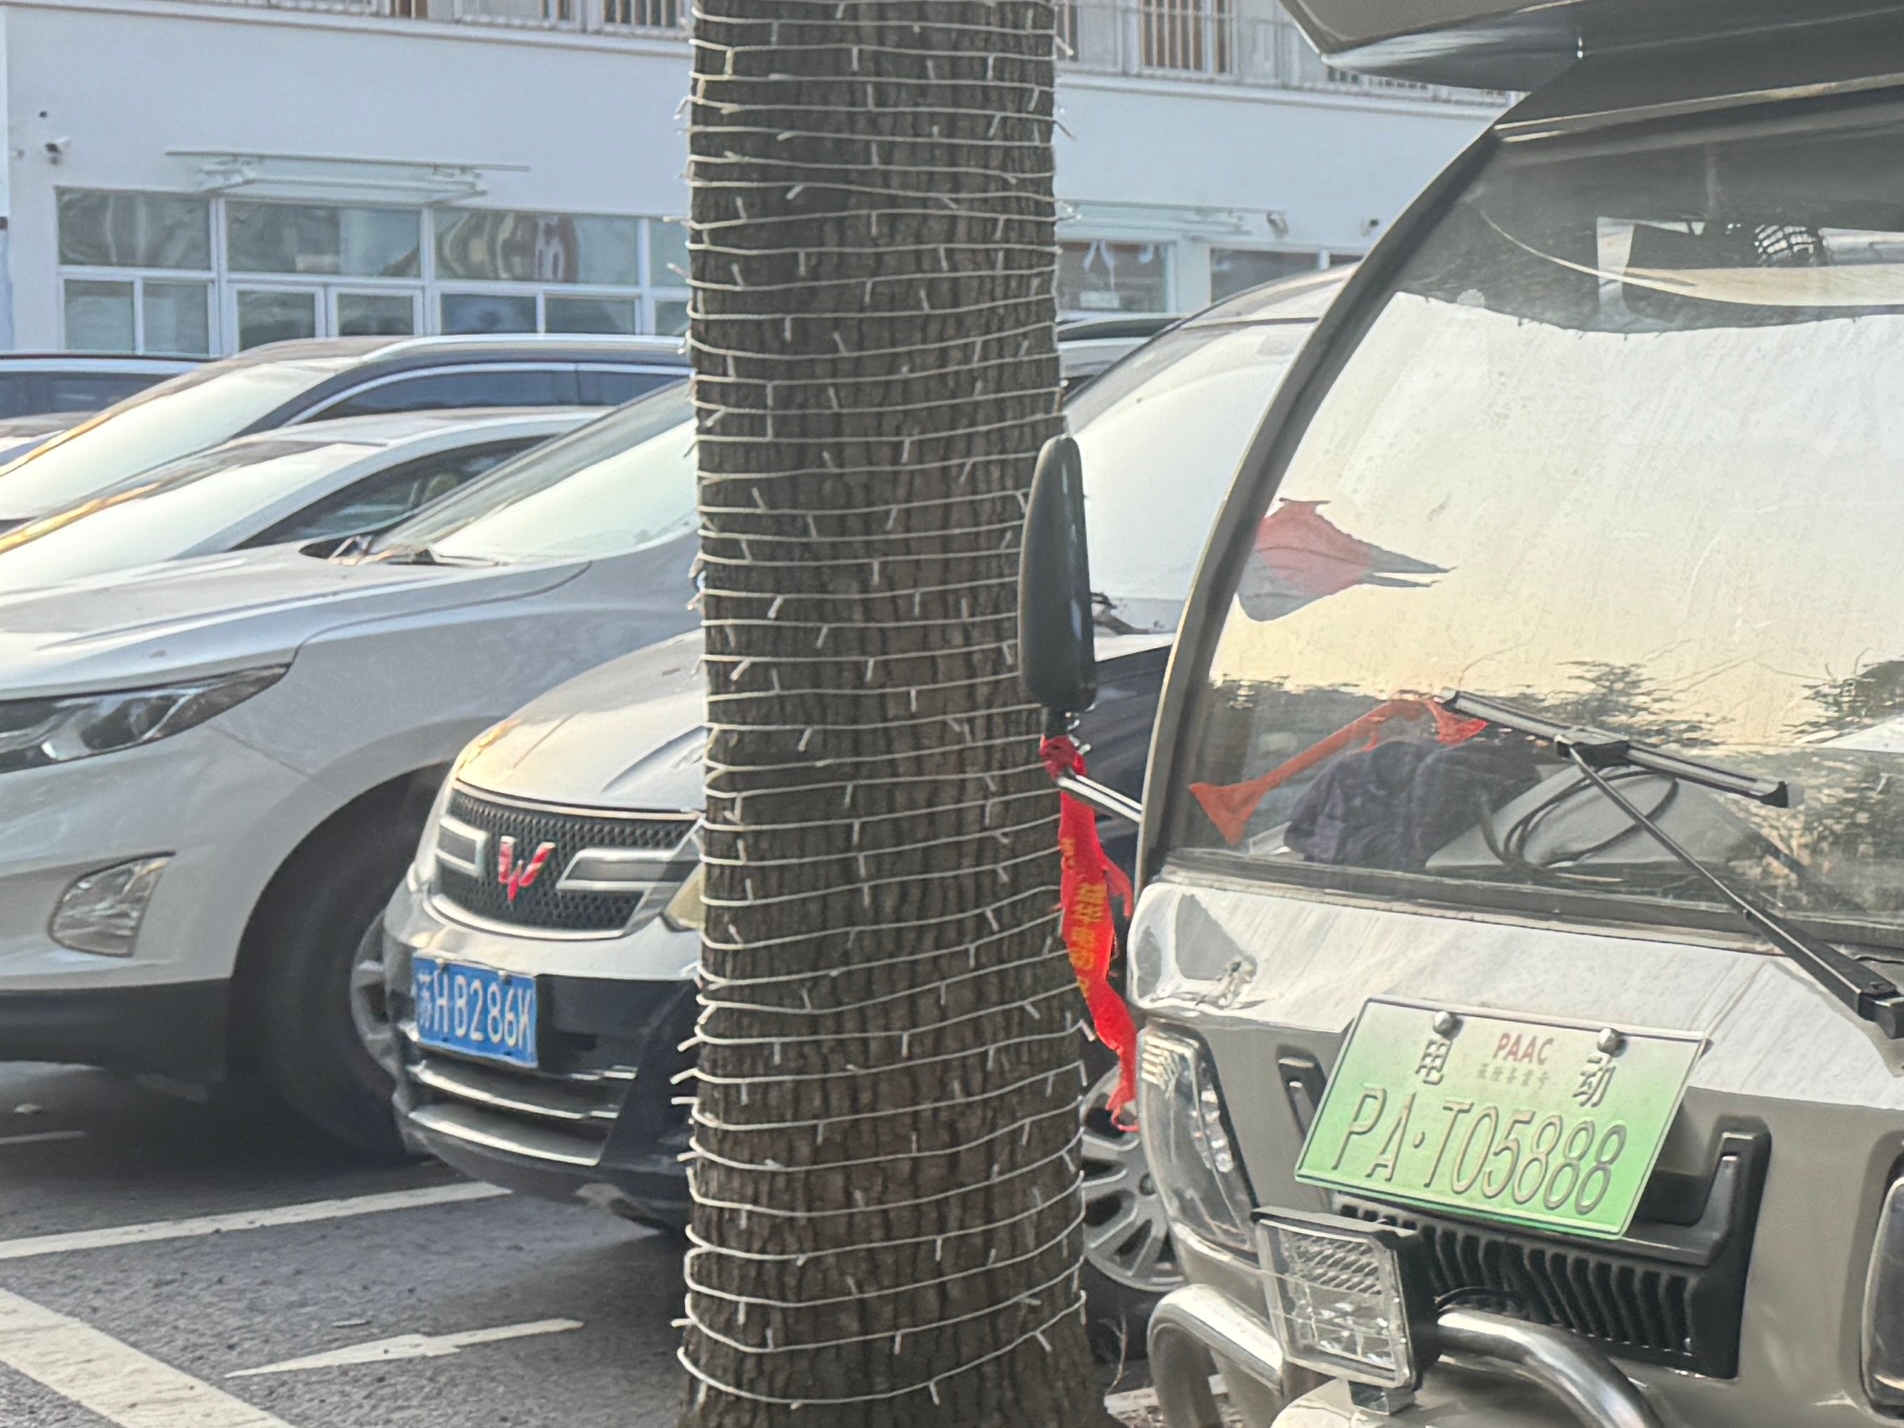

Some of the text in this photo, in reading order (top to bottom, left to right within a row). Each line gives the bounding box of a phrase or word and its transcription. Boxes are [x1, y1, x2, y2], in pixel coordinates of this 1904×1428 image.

[1415, 1037, 1452, 1086] 电
[1572, 1052, 1615, 1107] 动
[1492, 1032, 1555, 1066] PAAC
